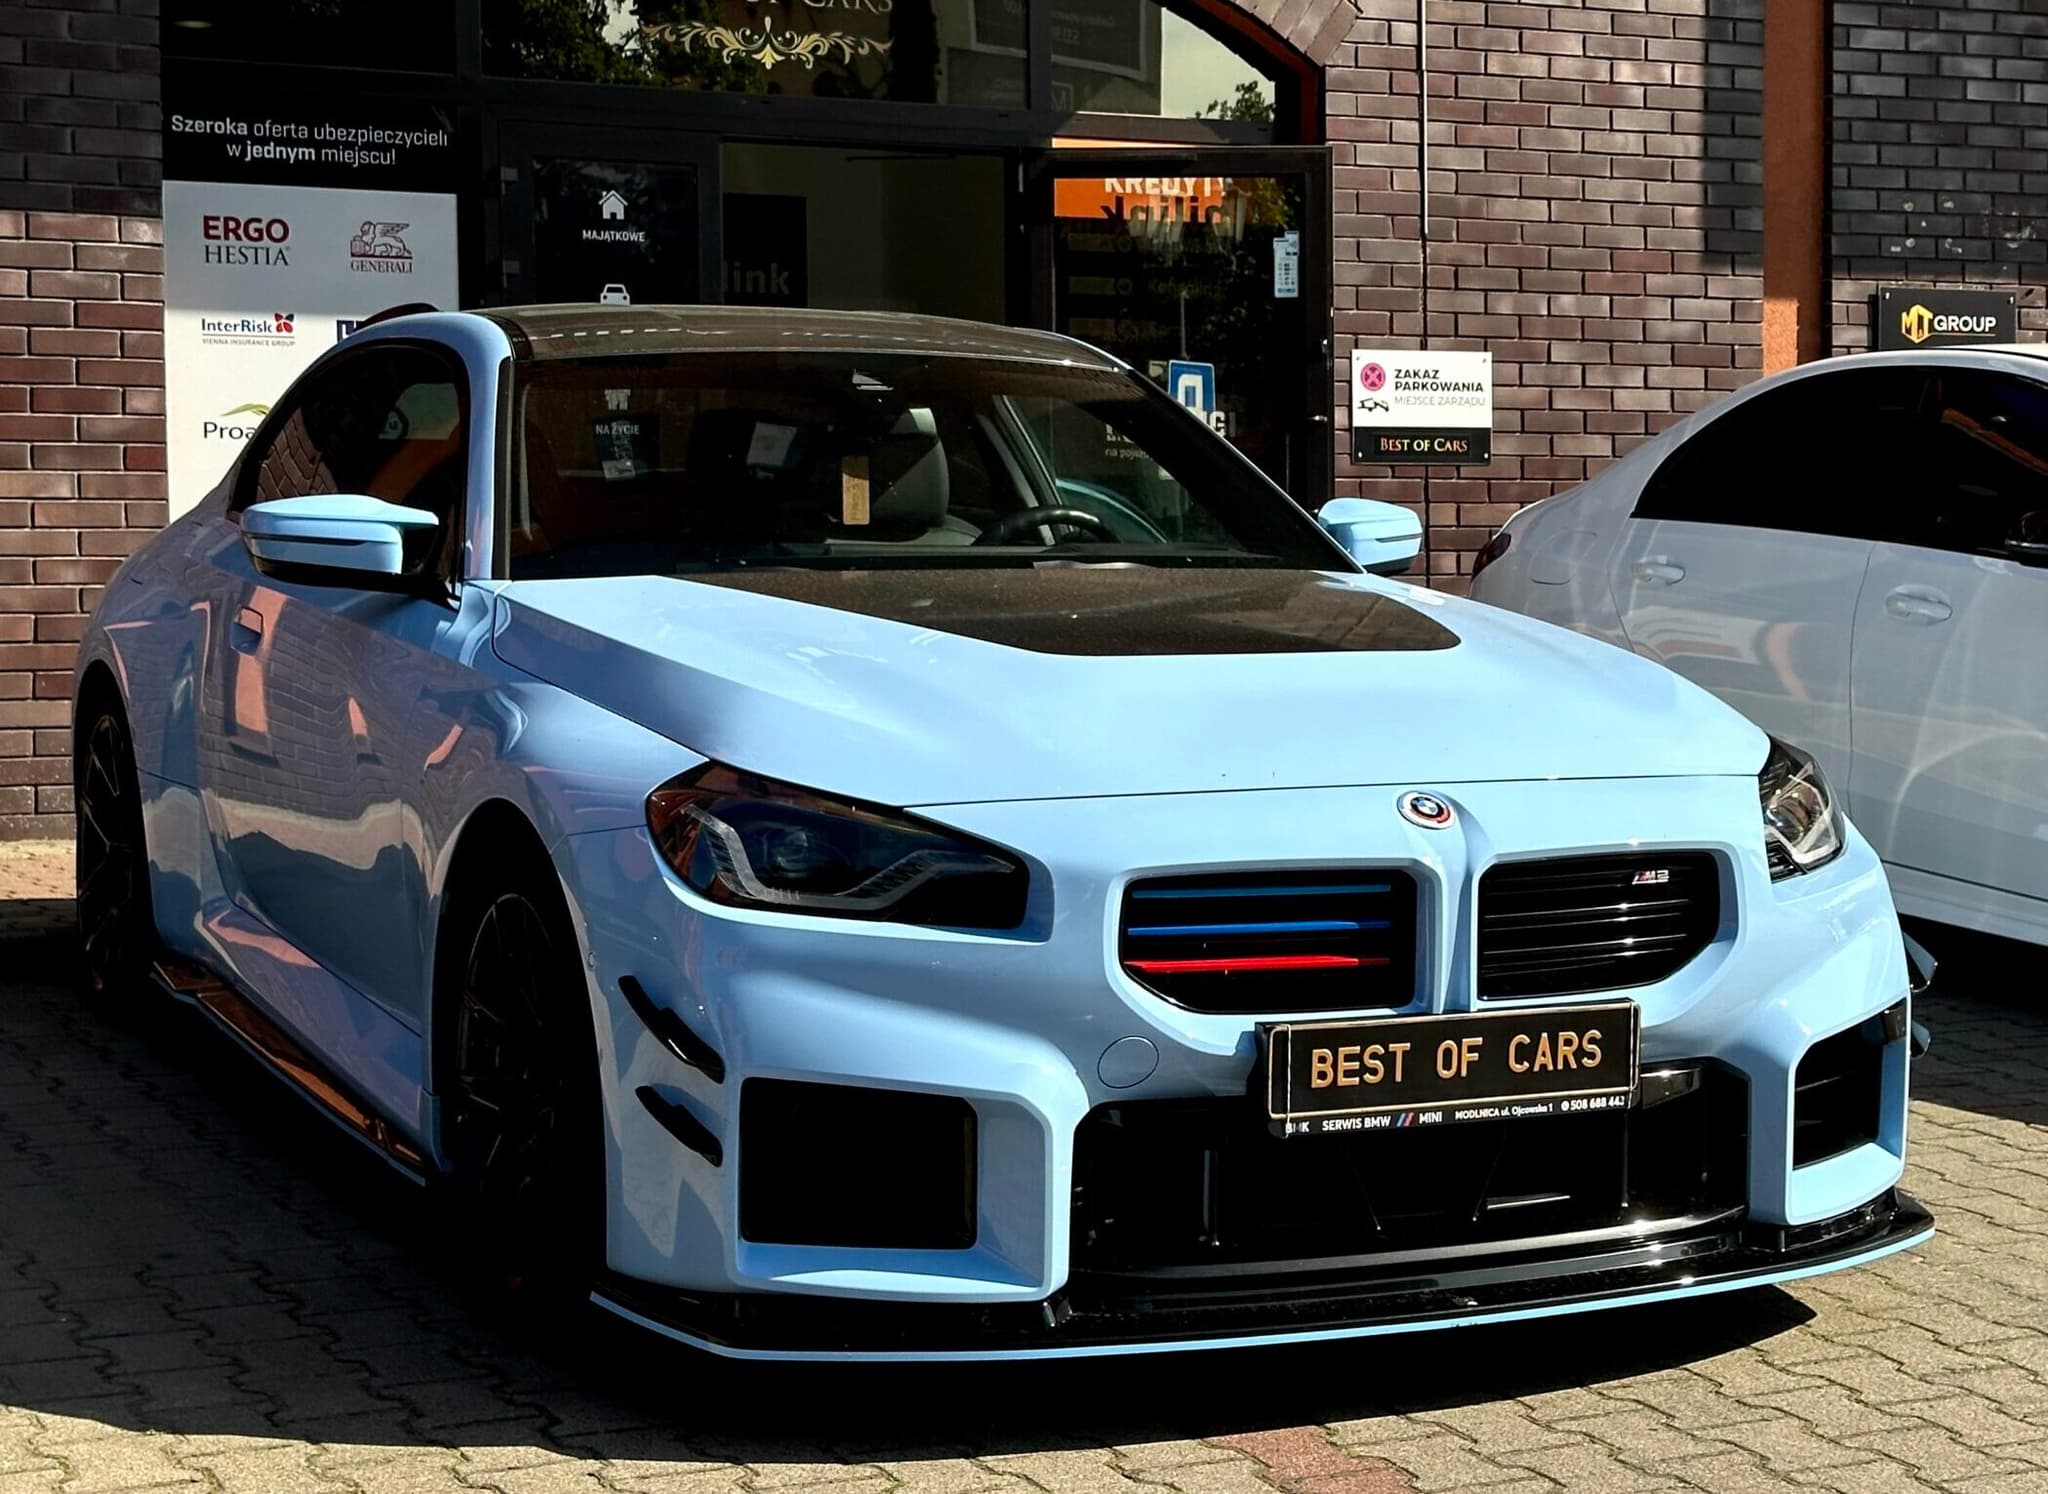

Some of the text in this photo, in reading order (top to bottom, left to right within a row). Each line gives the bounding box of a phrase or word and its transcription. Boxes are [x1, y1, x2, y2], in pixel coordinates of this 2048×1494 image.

[171, 115, 447, 149] Szeroka oferta ubezpieczycieli
[226, 140, 396, 168] w jednym miejscu!
[203, 215, 290, 243] ERGO
[582, 230, 646, 243] MAJĄTKOWE
[204, 245, 289, 266] HESTIA
[350, 260, 413, 273] GENERALI
[201, 317, 273, 334] InterRisk
[1933, 315, 1997, 332] GROUP
[1395, 369, 1440, 380] ZAKAZ
[1395, 381, 1484, 393] PARKOWANIA
[1395, 395, 1486, 408] MIEJSCE ZARZĄDU
[203, 421, 257, 439] Proa
[595, 423, 610, 435] NA
[1310, 1029, 1603, 1089] BEST OF CARS
[1321, 1118, 1362, 1131] SERWIS
[1364, 1115, 1391, 1129] BMW
[1419, 1111, 1443, 1124] MINI
[1455, 1107, 1500, 1121] MODLNICA
[1570, 1098, 1588, 1111] 508
